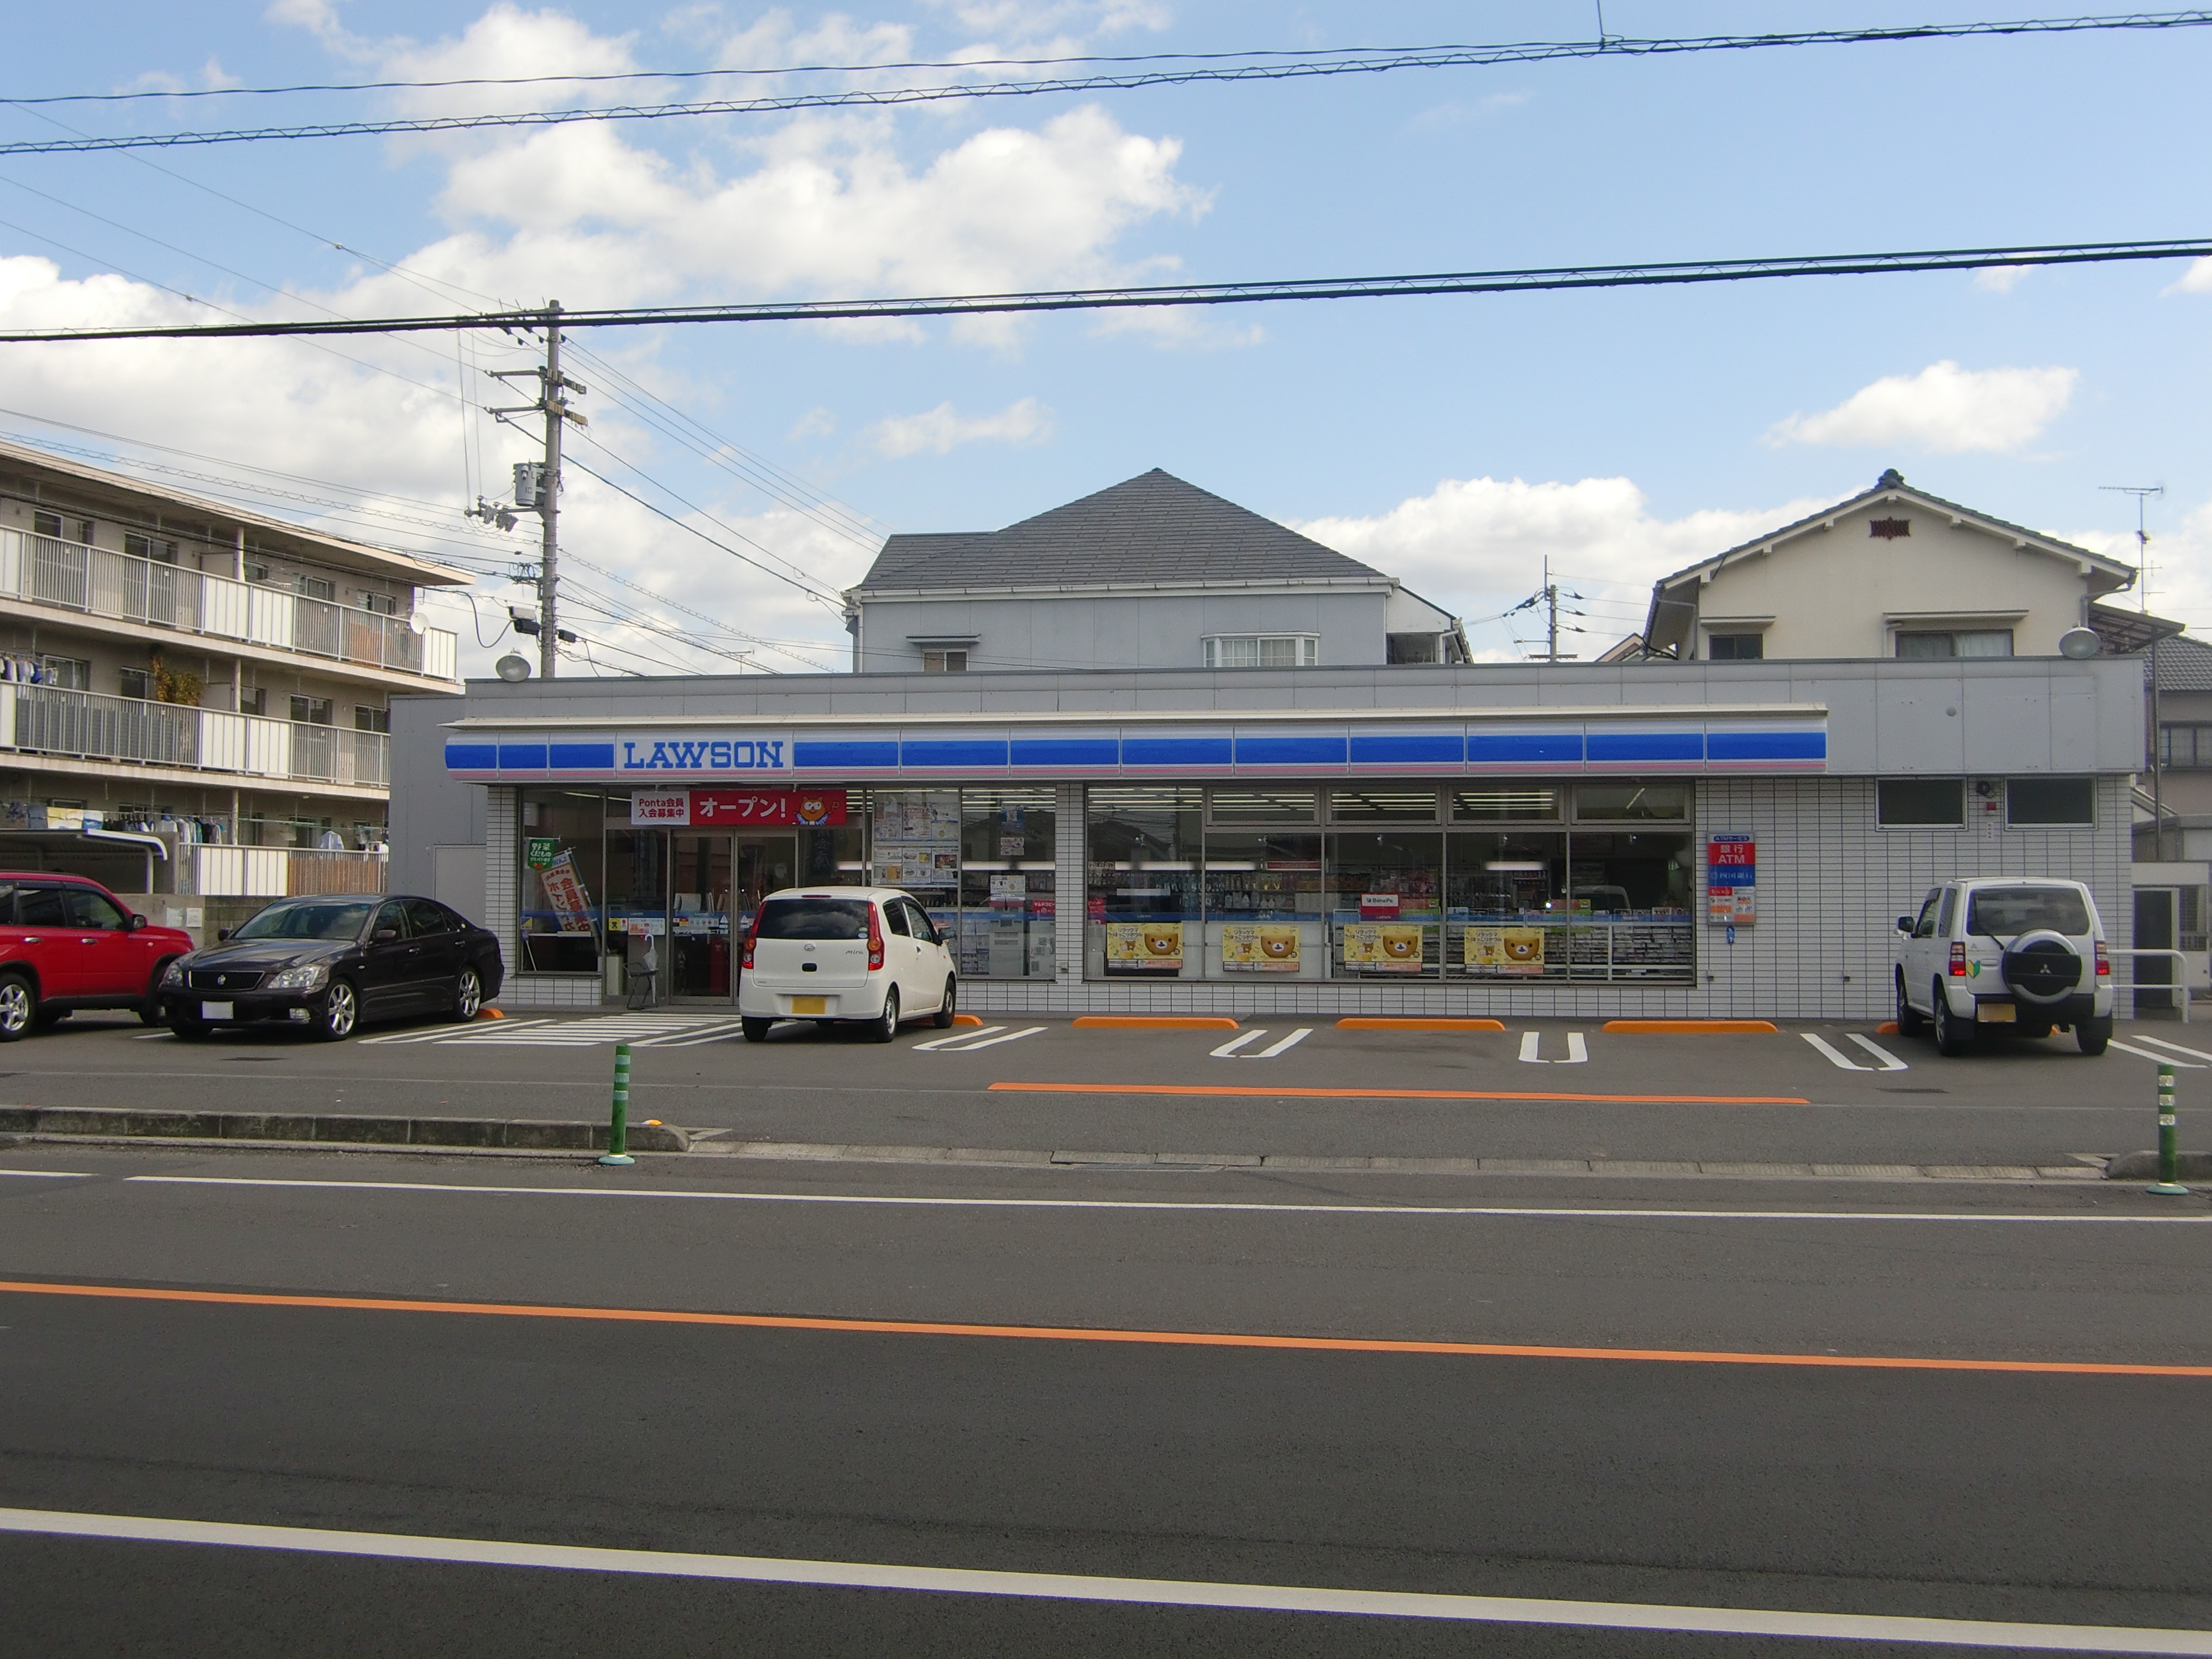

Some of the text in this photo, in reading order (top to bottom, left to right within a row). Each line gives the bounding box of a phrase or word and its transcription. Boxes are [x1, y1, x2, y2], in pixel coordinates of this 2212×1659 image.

[624, 741, 784, 769] LAWSON
[639, 797, 684, 807] Ponta会員
[700, 796, 786, 818] オープン!
[639, 808, 684, 818] 入会募集中
[531, 842, 551, 851] 野菜
[1718, 854, 1745, 864] ATM
